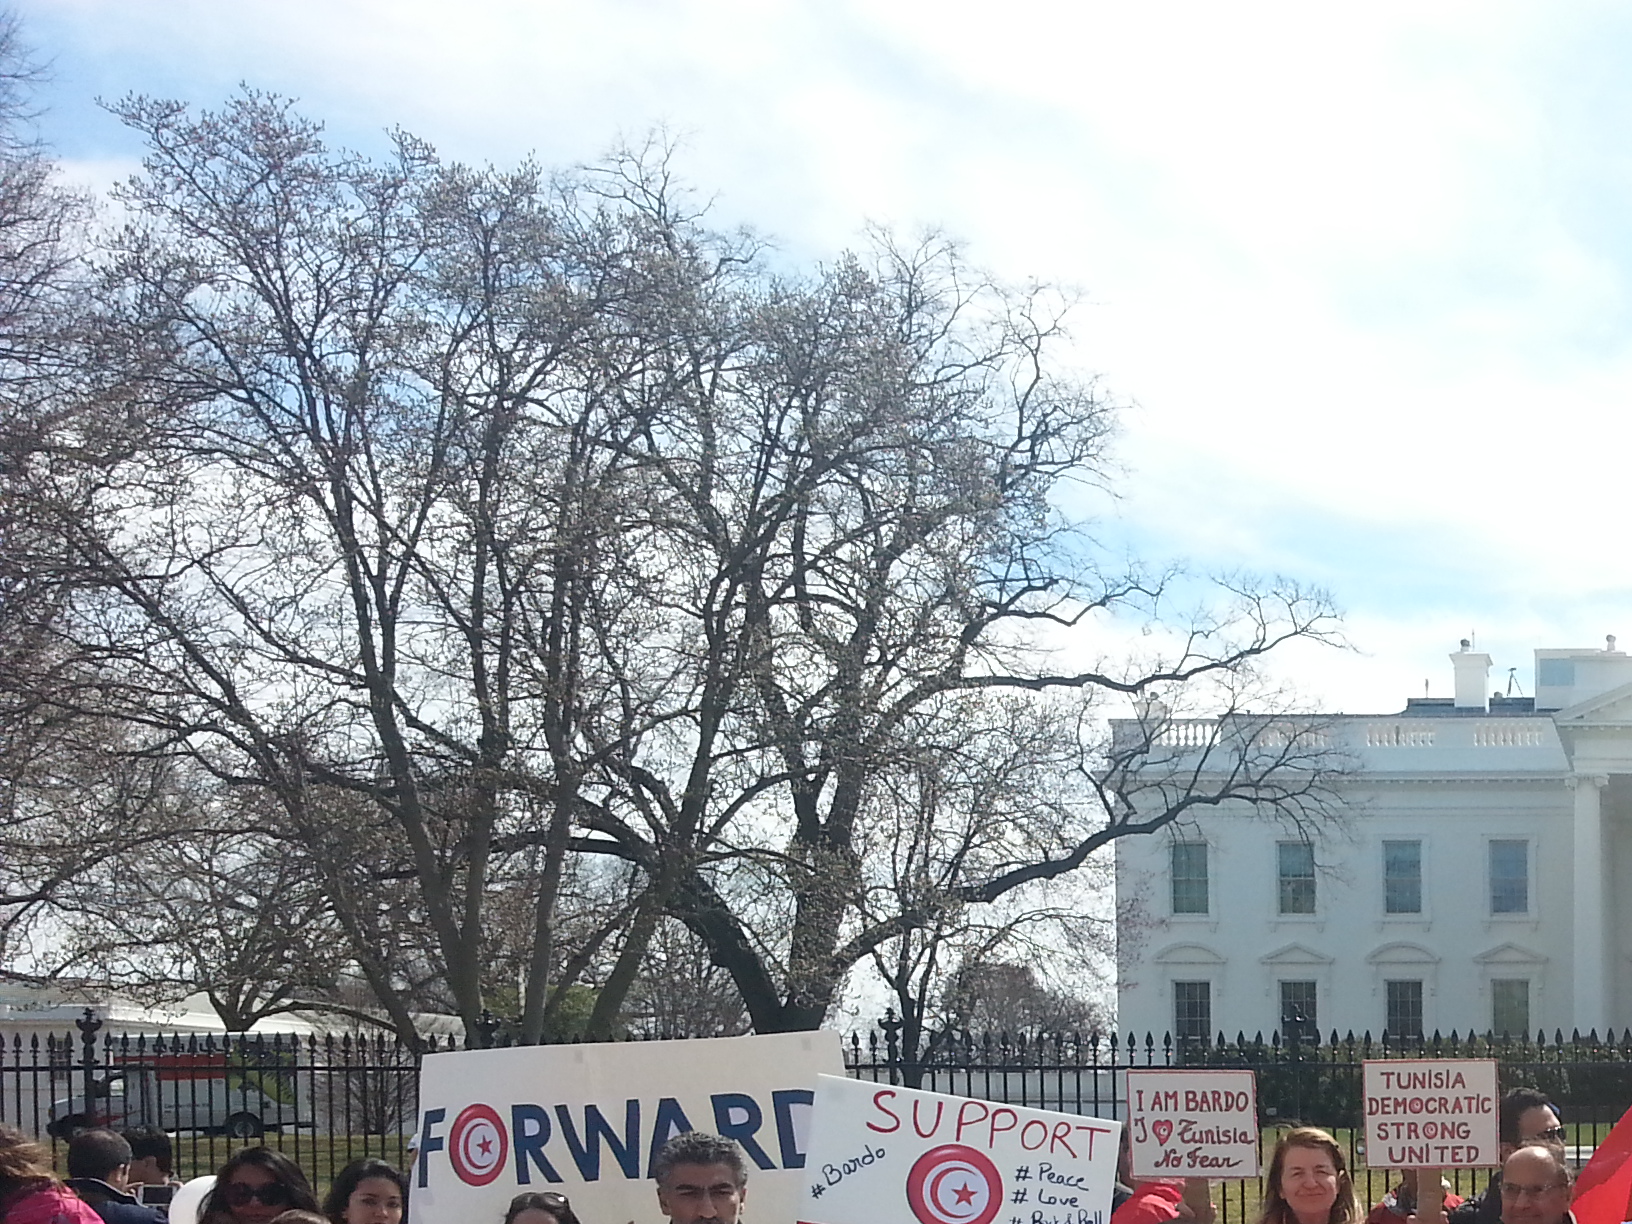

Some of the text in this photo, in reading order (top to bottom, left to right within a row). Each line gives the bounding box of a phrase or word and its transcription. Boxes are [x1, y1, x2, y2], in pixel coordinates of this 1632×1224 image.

[1380, 1069, 1466, 1090] TUNISIA
[1136, 1090, 1249, 1112] I AM BARDO
[1367, 1094, 1492, 1117] DEMOCRATIC
[866, 1090, 1111, 1161] SUPPORT
[1177, 1118, 1255, 1146] Tunisia
[1377, 1121, 1471, 1141] STRONG
[1154, 1147, 1243, 1169] No Fear
[1389, 1142, 1479, 1164] UNITED
[811, 1145, 886, 1199] #Bardo
